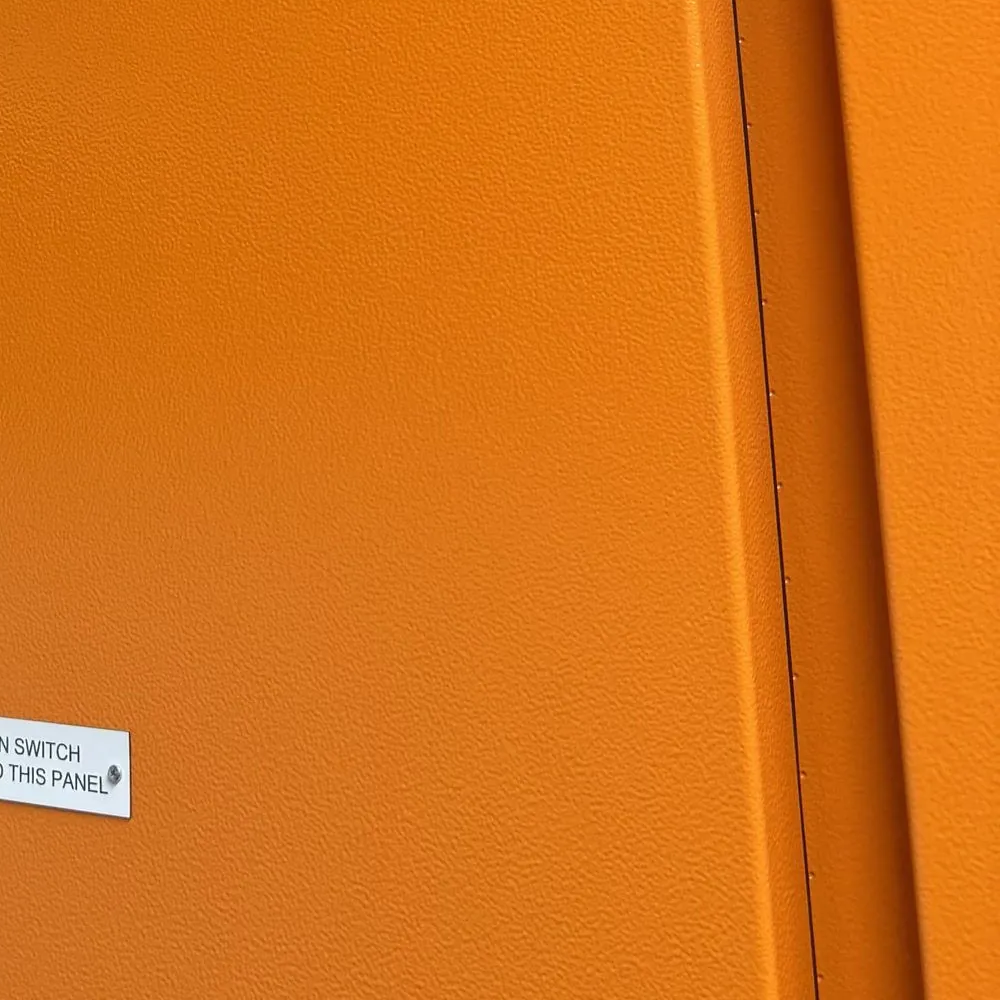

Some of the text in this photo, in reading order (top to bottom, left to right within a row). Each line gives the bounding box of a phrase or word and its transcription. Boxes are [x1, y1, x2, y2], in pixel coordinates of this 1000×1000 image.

[14, 737, 81, 763] SWITCH
[8, 764, 46, 786] THIS
[52, 769, 109, 795] PANEL
